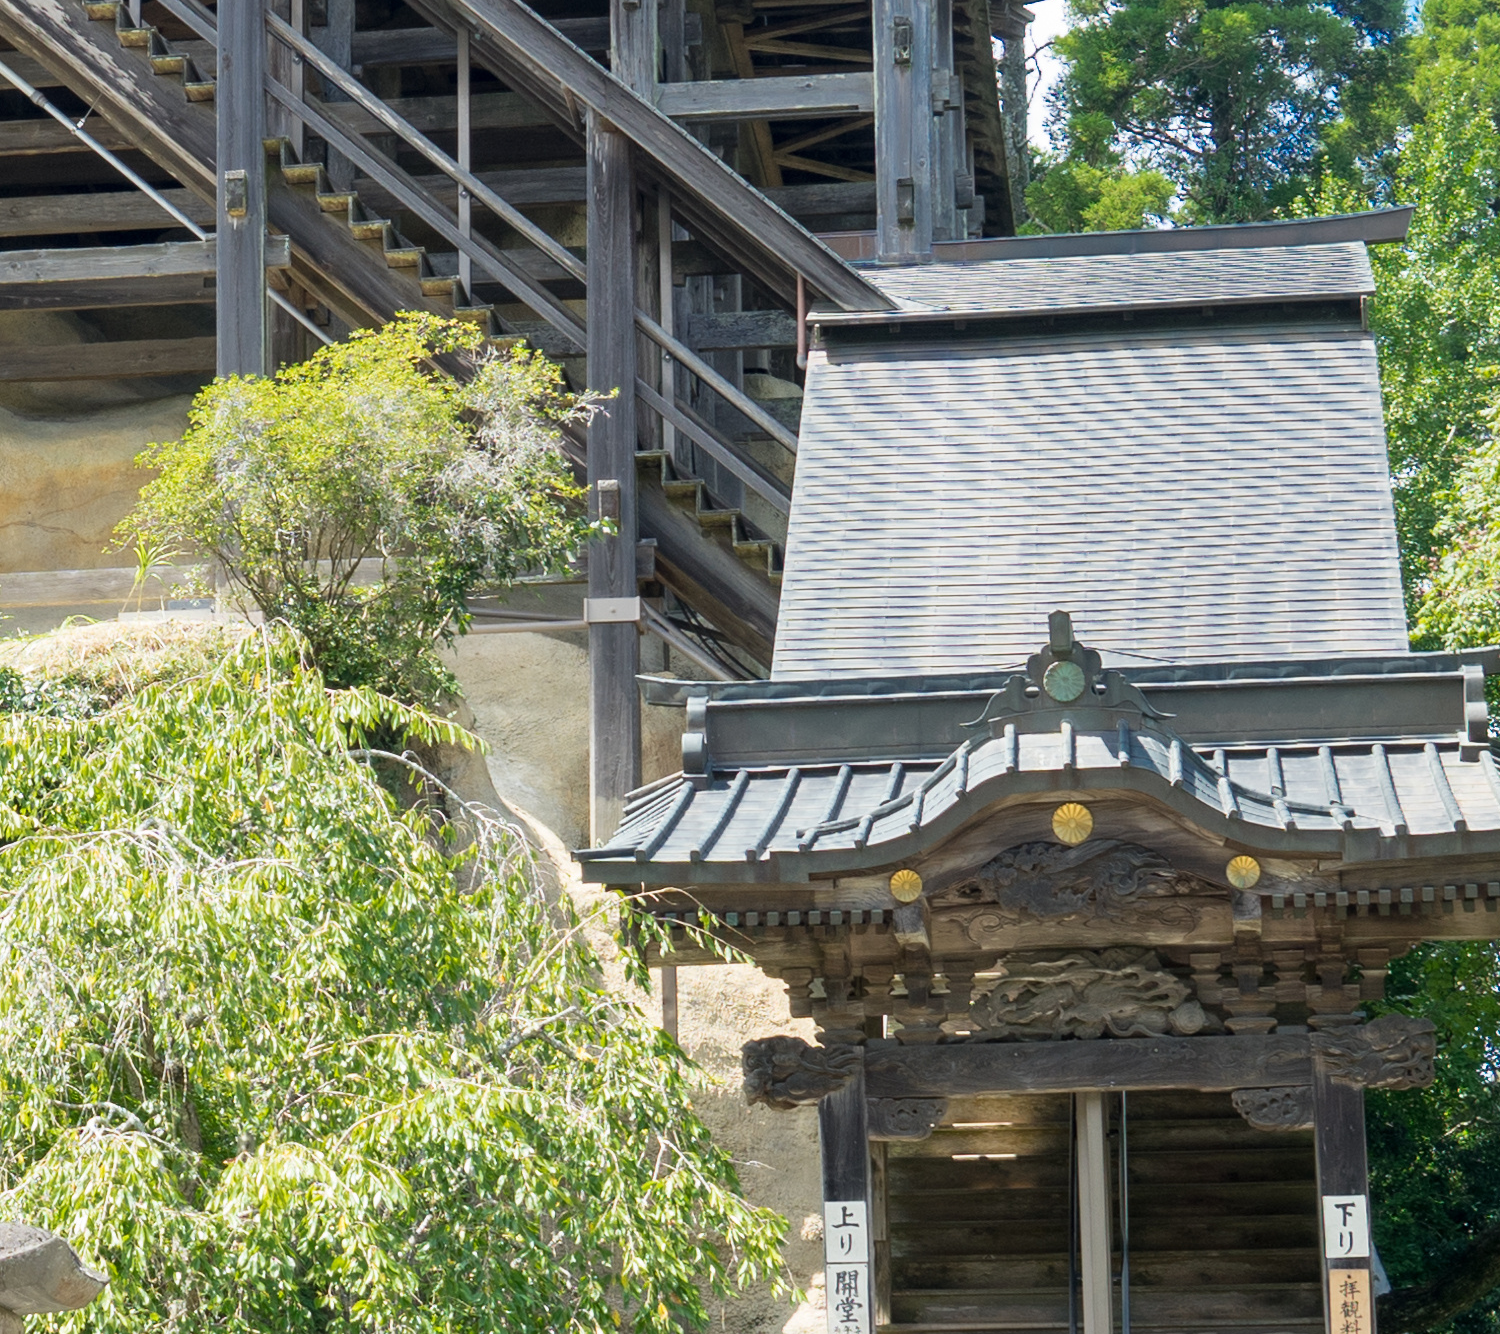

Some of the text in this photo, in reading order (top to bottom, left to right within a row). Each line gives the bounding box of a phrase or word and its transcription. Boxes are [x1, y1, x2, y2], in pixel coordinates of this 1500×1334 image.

[832, 1205, 860, 1255] 上り
[1333, 1202, 1356, 1255] 下り
[835, 1270, 863, 1323] 開堂
